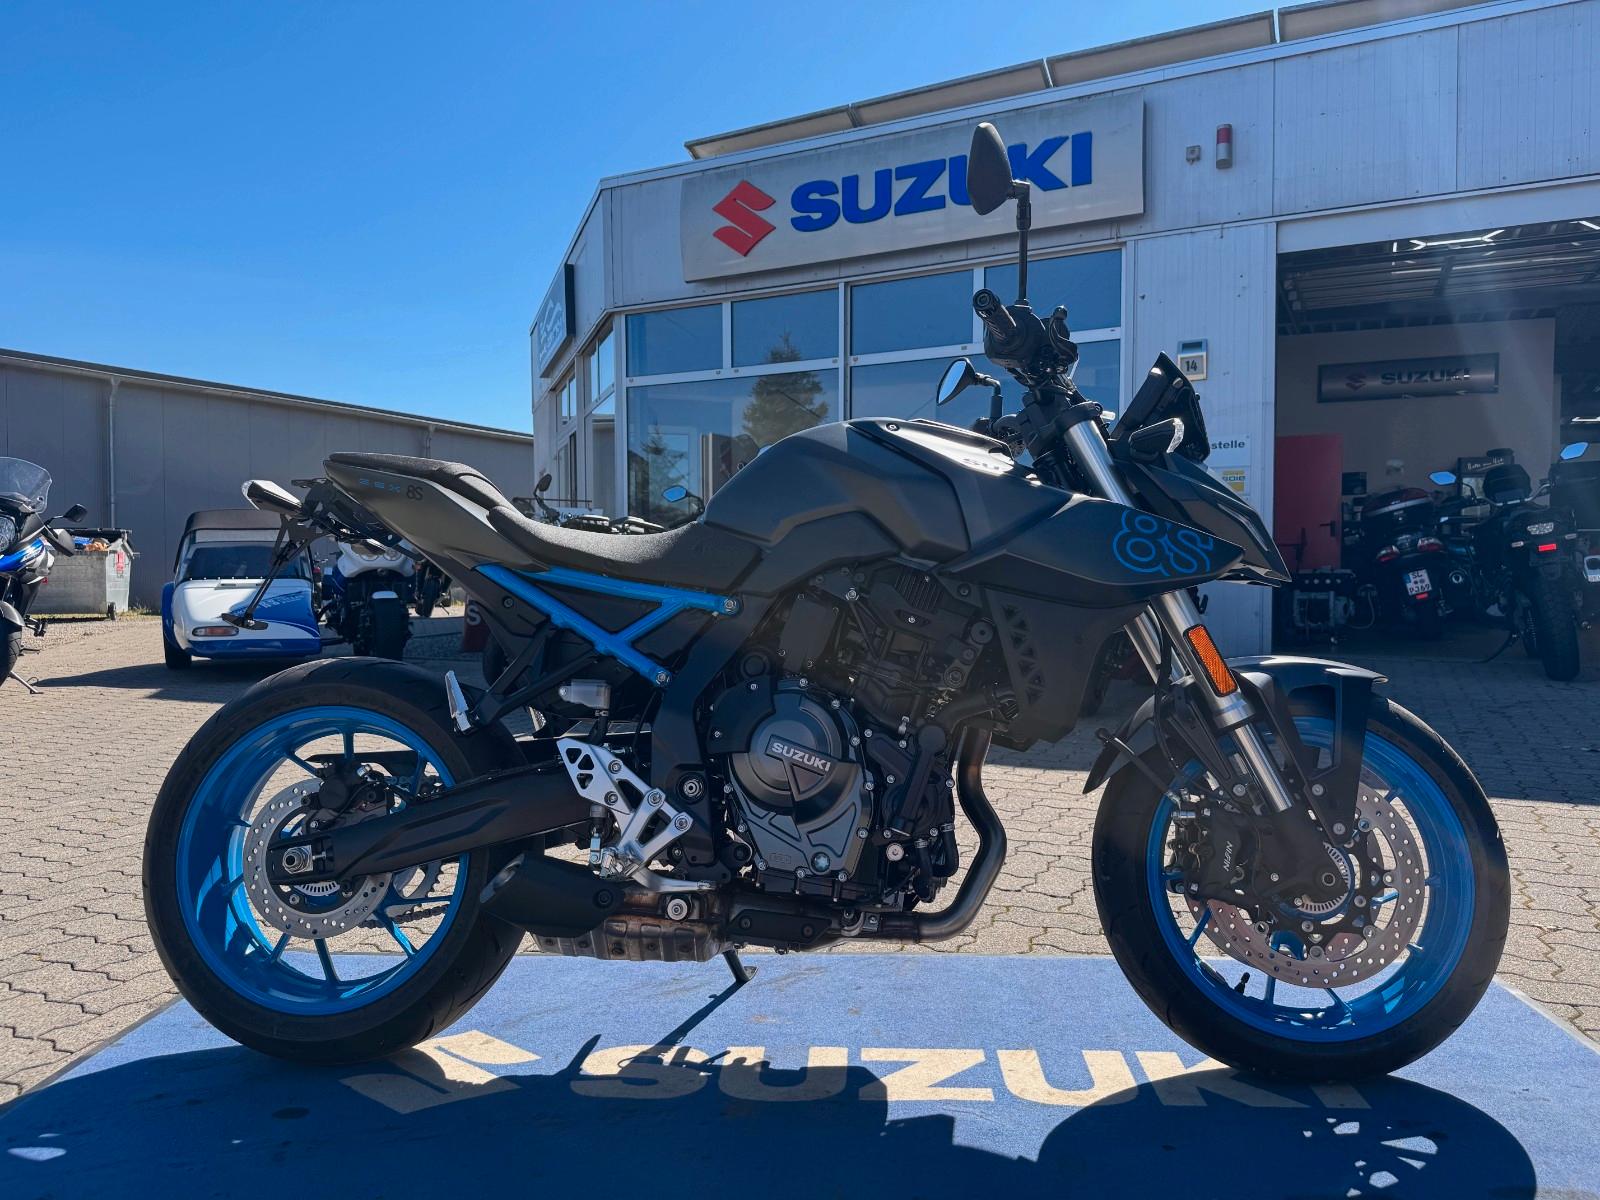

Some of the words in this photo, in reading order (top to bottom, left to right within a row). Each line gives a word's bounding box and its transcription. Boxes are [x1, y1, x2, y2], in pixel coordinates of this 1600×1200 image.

[1185, 360, 1198, 372] 14
[1380, 367, 1472, 385] SUZUKI
[771, 742, 831, 772] SUZUKI
